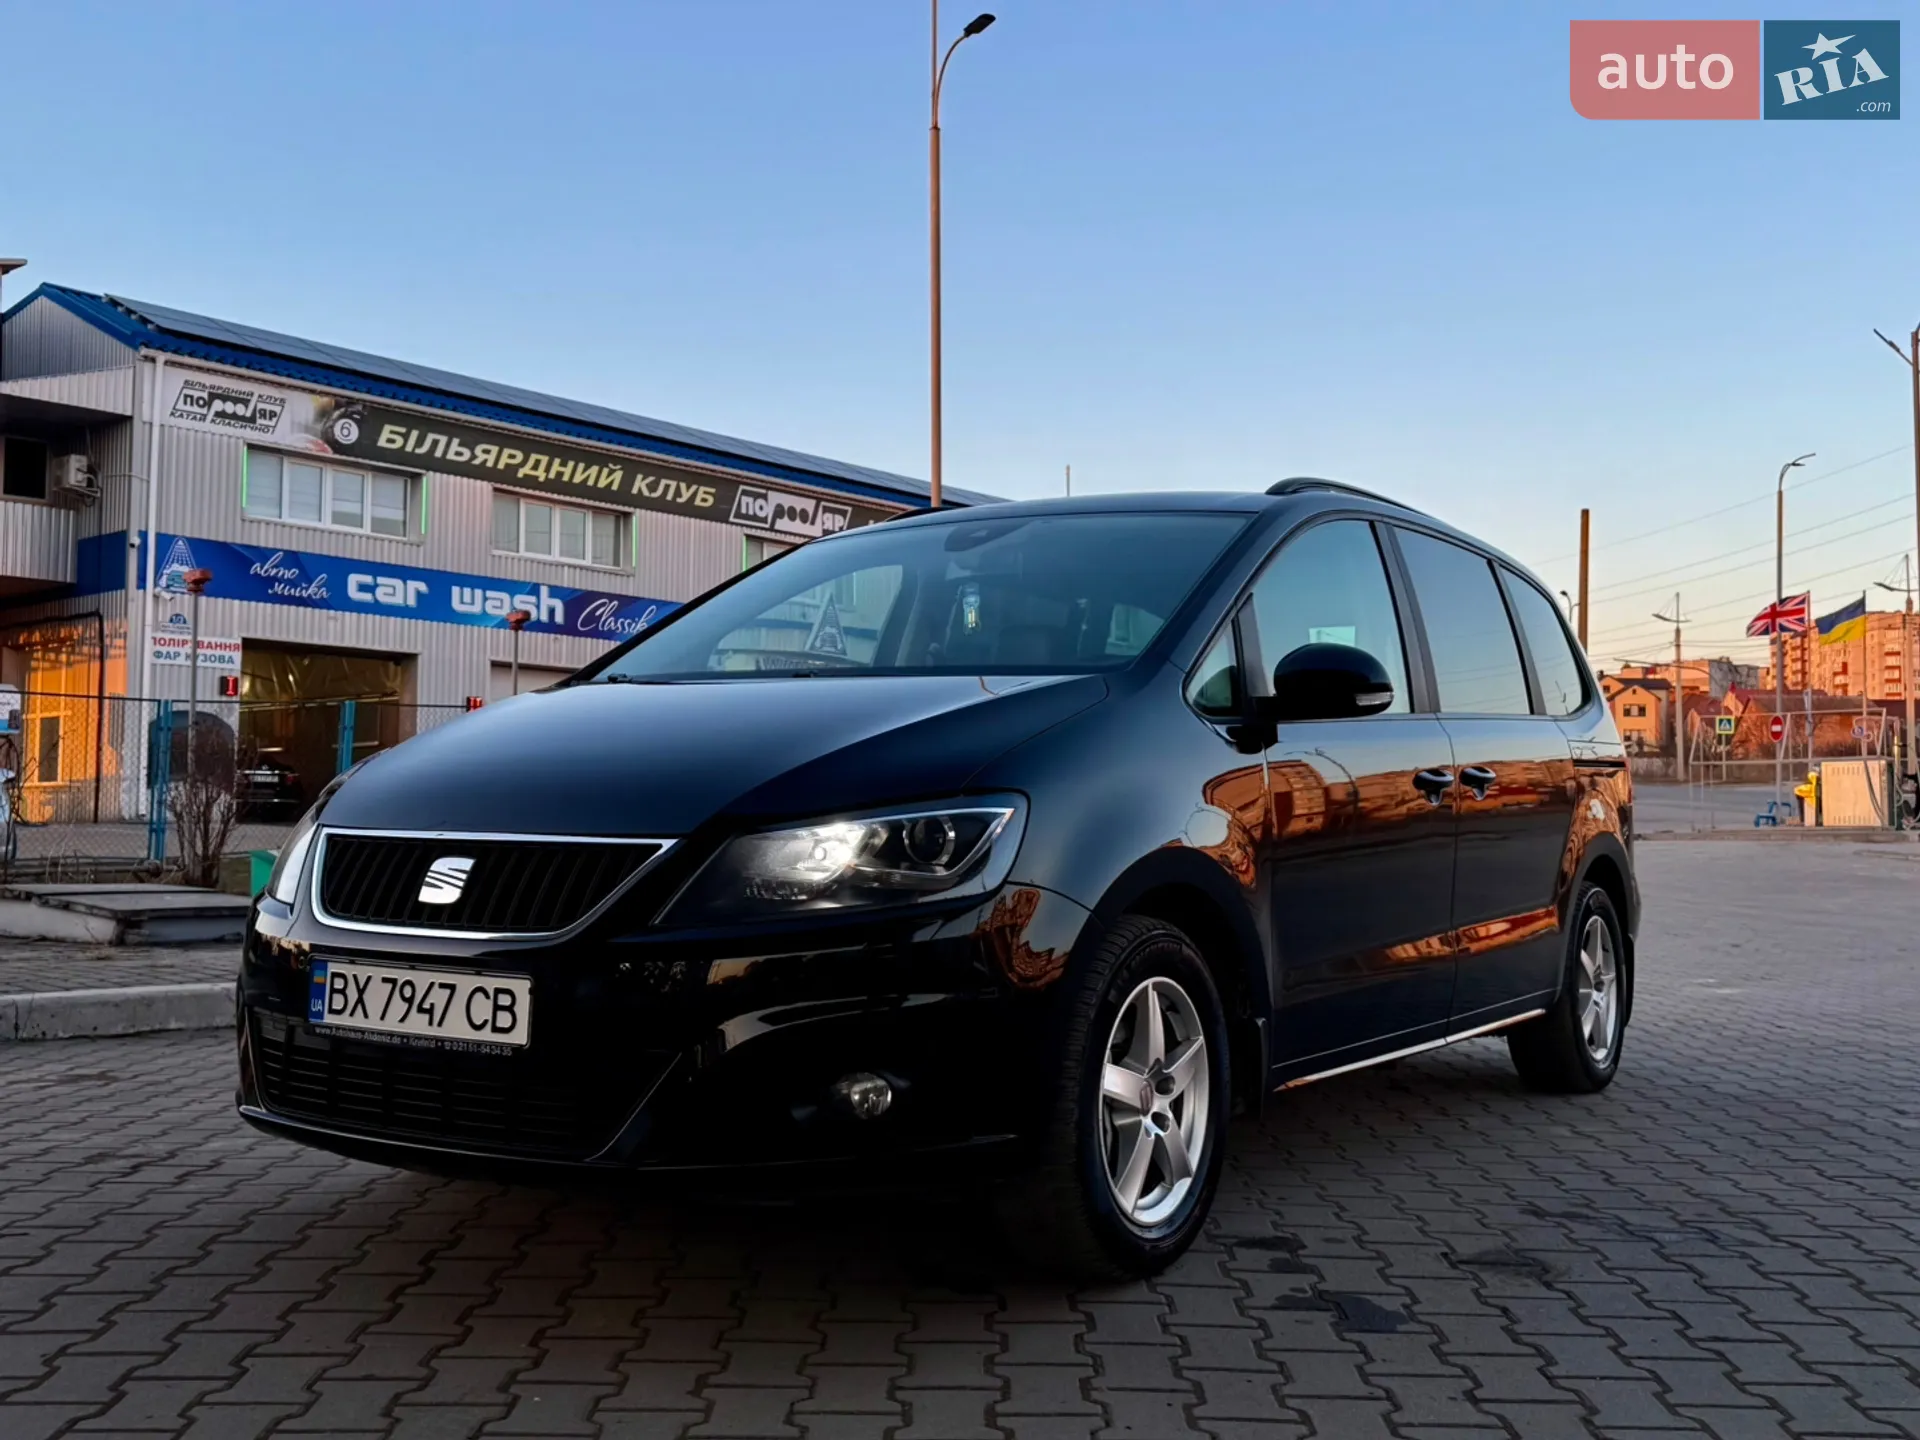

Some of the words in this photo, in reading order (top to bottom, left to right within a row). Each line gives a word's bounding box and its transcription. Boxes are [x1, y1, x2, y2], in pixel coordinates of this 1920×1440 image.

[183, 379, 254, 398] БІЛЬЯРДНИЙ
[257, 394, 287, 404] КЛУБ
[376, 424, 625, 491] БІЛЬЯРДНИЙ
[631, 473, 717, 508] КЛУБ
[250, 551, 300, 579] авто
[268, 573, 333, 600] мийка
[347, 573, 430, 608] car
[451, 584, 565, 625] wash
[151, 636, 241, 653] ПОЛІРВАННЯ
[153, 650, 181, 661] ФАР
[311, 998, 323, 1012] UA
[327, 971, 373, 1020] BX
[379, 976, 457, 1028] 7947
[465, 985, 517, 1035] CB
